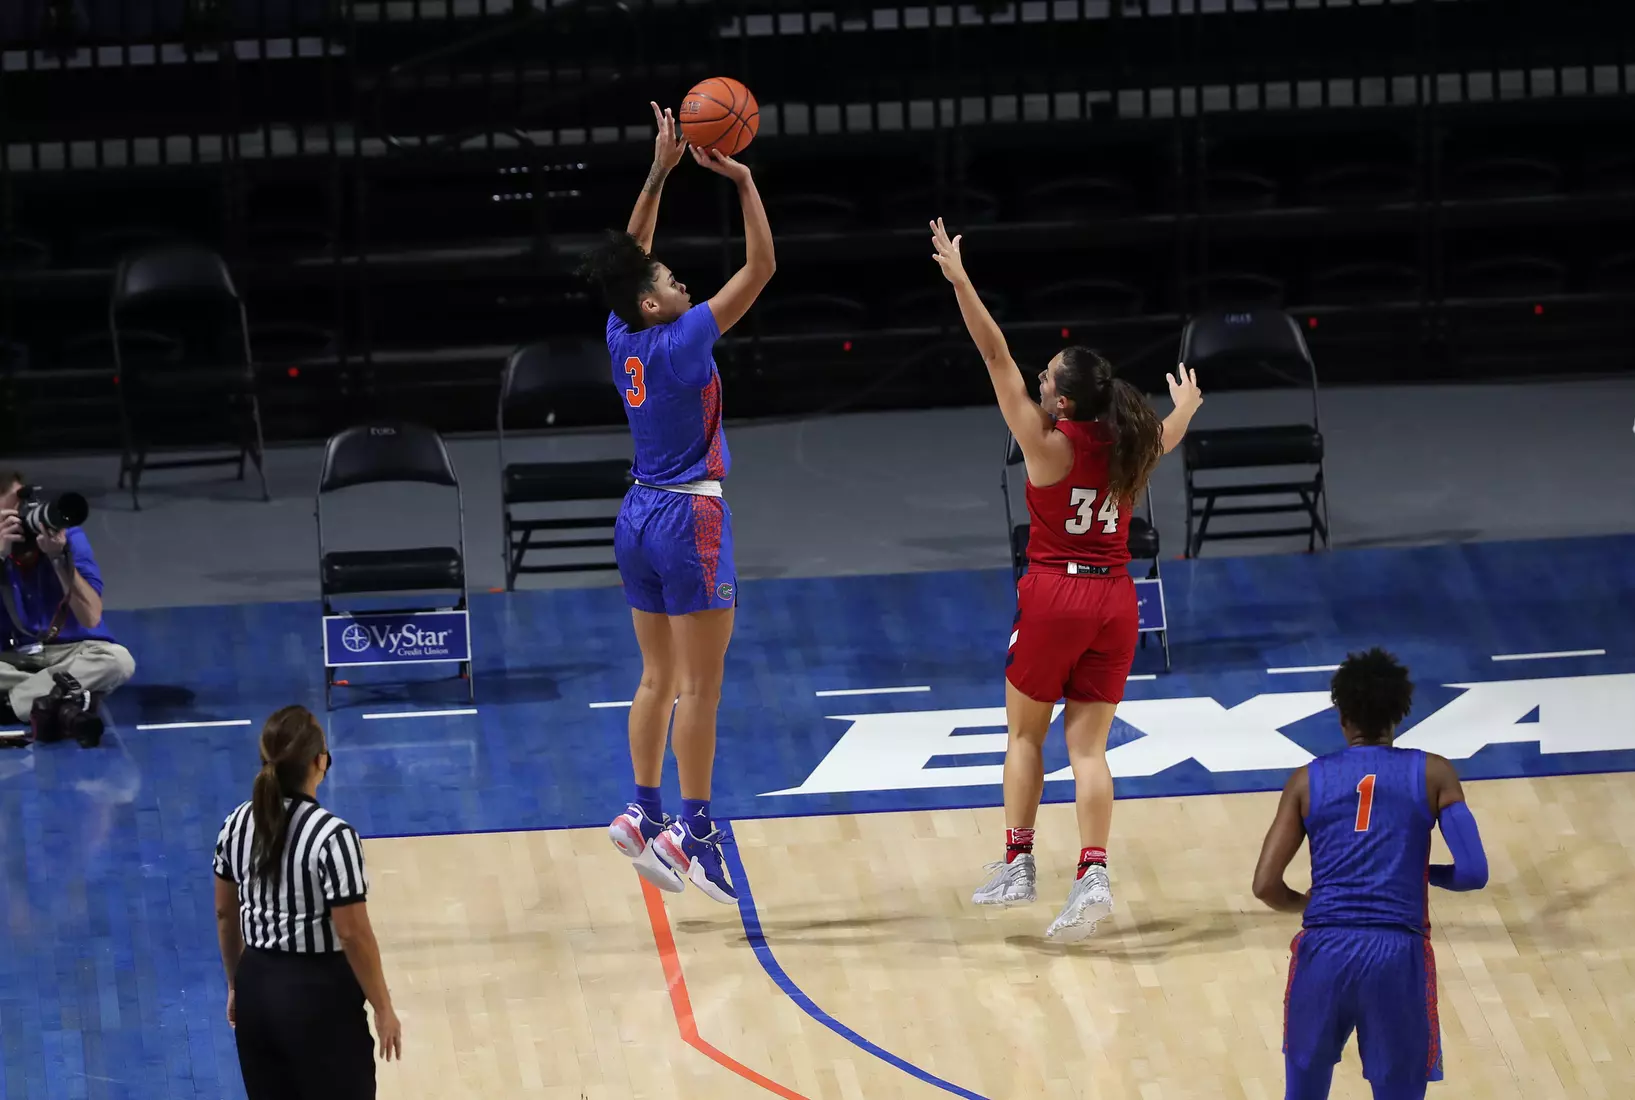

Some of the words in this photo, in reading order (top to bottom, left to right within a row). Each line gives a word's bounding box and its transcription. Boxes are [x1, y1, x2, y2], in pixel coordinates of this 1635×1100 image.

[624, 356, 647, 408] 3
[1064, 486, 1119, 535] 34
[370, 624, 448, 654] VyStar
[397, 647, 422, 656] Credit
[424, 647, 449, 655] Union
[1354, 774, 1377, 832] 1
